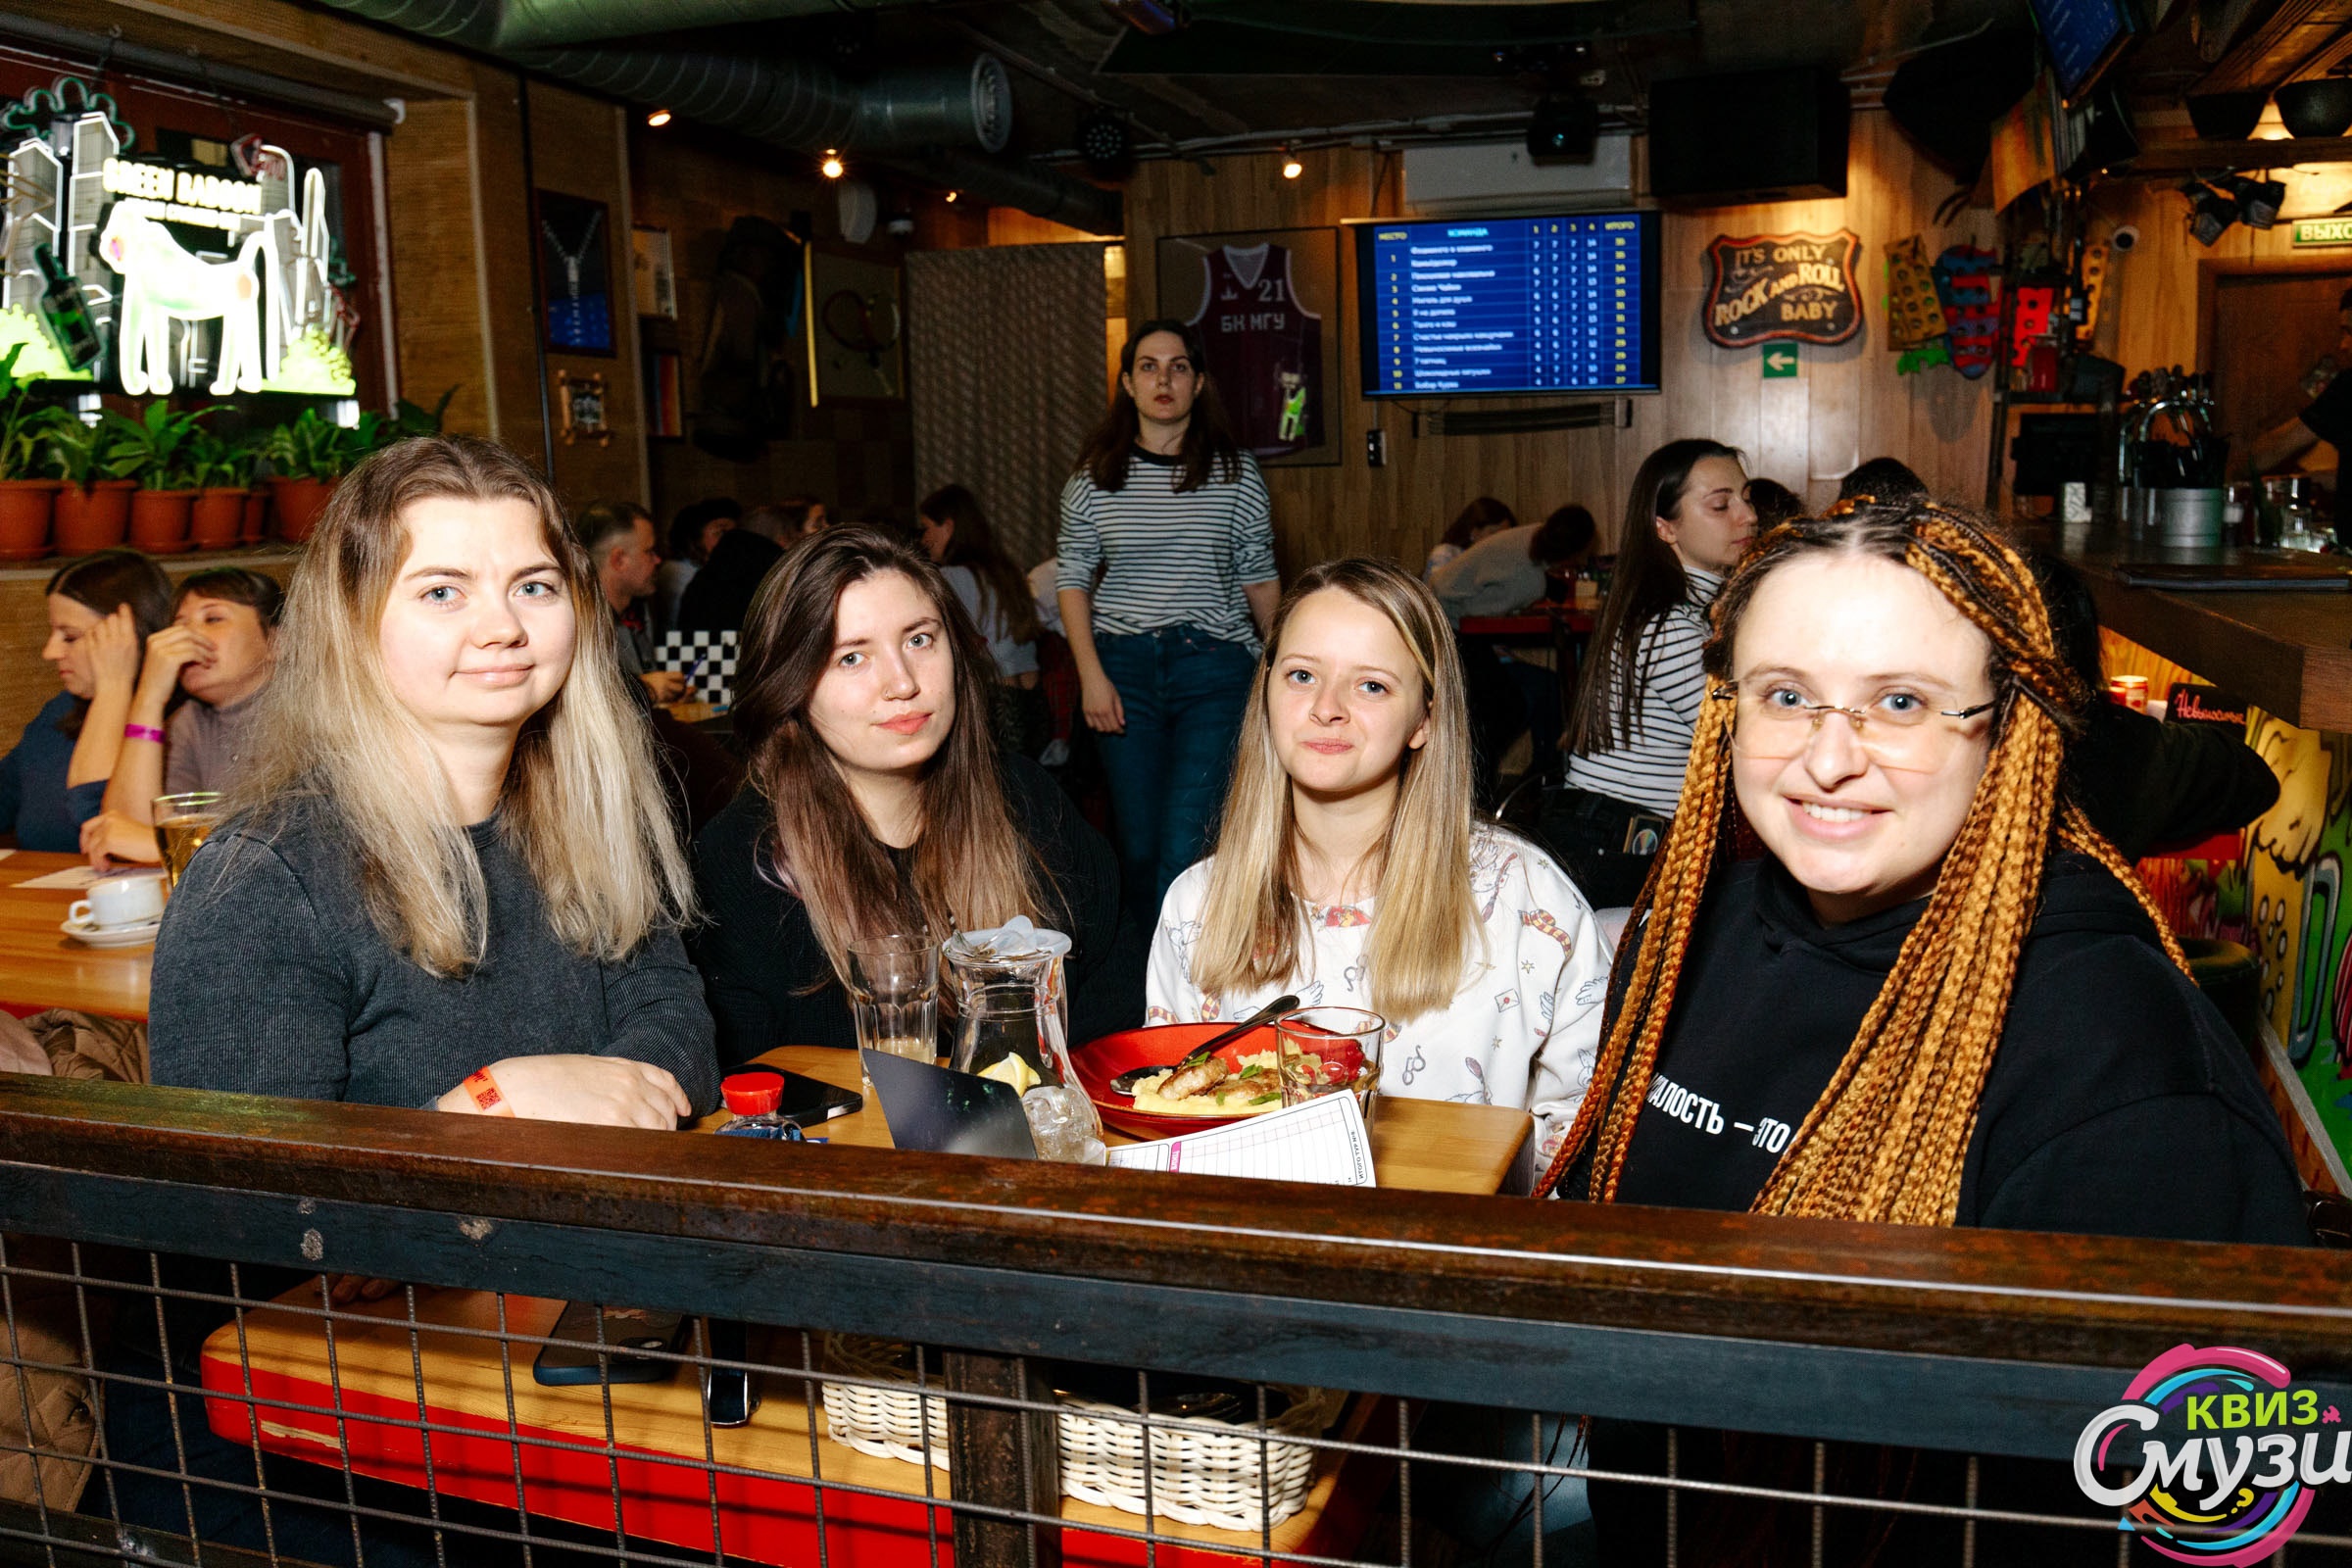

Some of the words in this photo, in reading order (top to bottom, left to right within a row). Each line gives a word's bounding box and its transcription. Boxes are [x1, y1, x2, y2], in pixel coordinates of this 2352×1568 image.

[1773, 244, 1827, 263] ONLY
[1258, 278, 1285, 302] 21
[1715, 277, 1769, 326] ROCK
[1770, 272, 1799, 298] AND
[1797, 262, 1845, 293] ROLL
[1780, 300, 1838, 322] BABY
[1220, 315, 1246, 333] БК
[1250, 313, 1285, 330] МГУ
